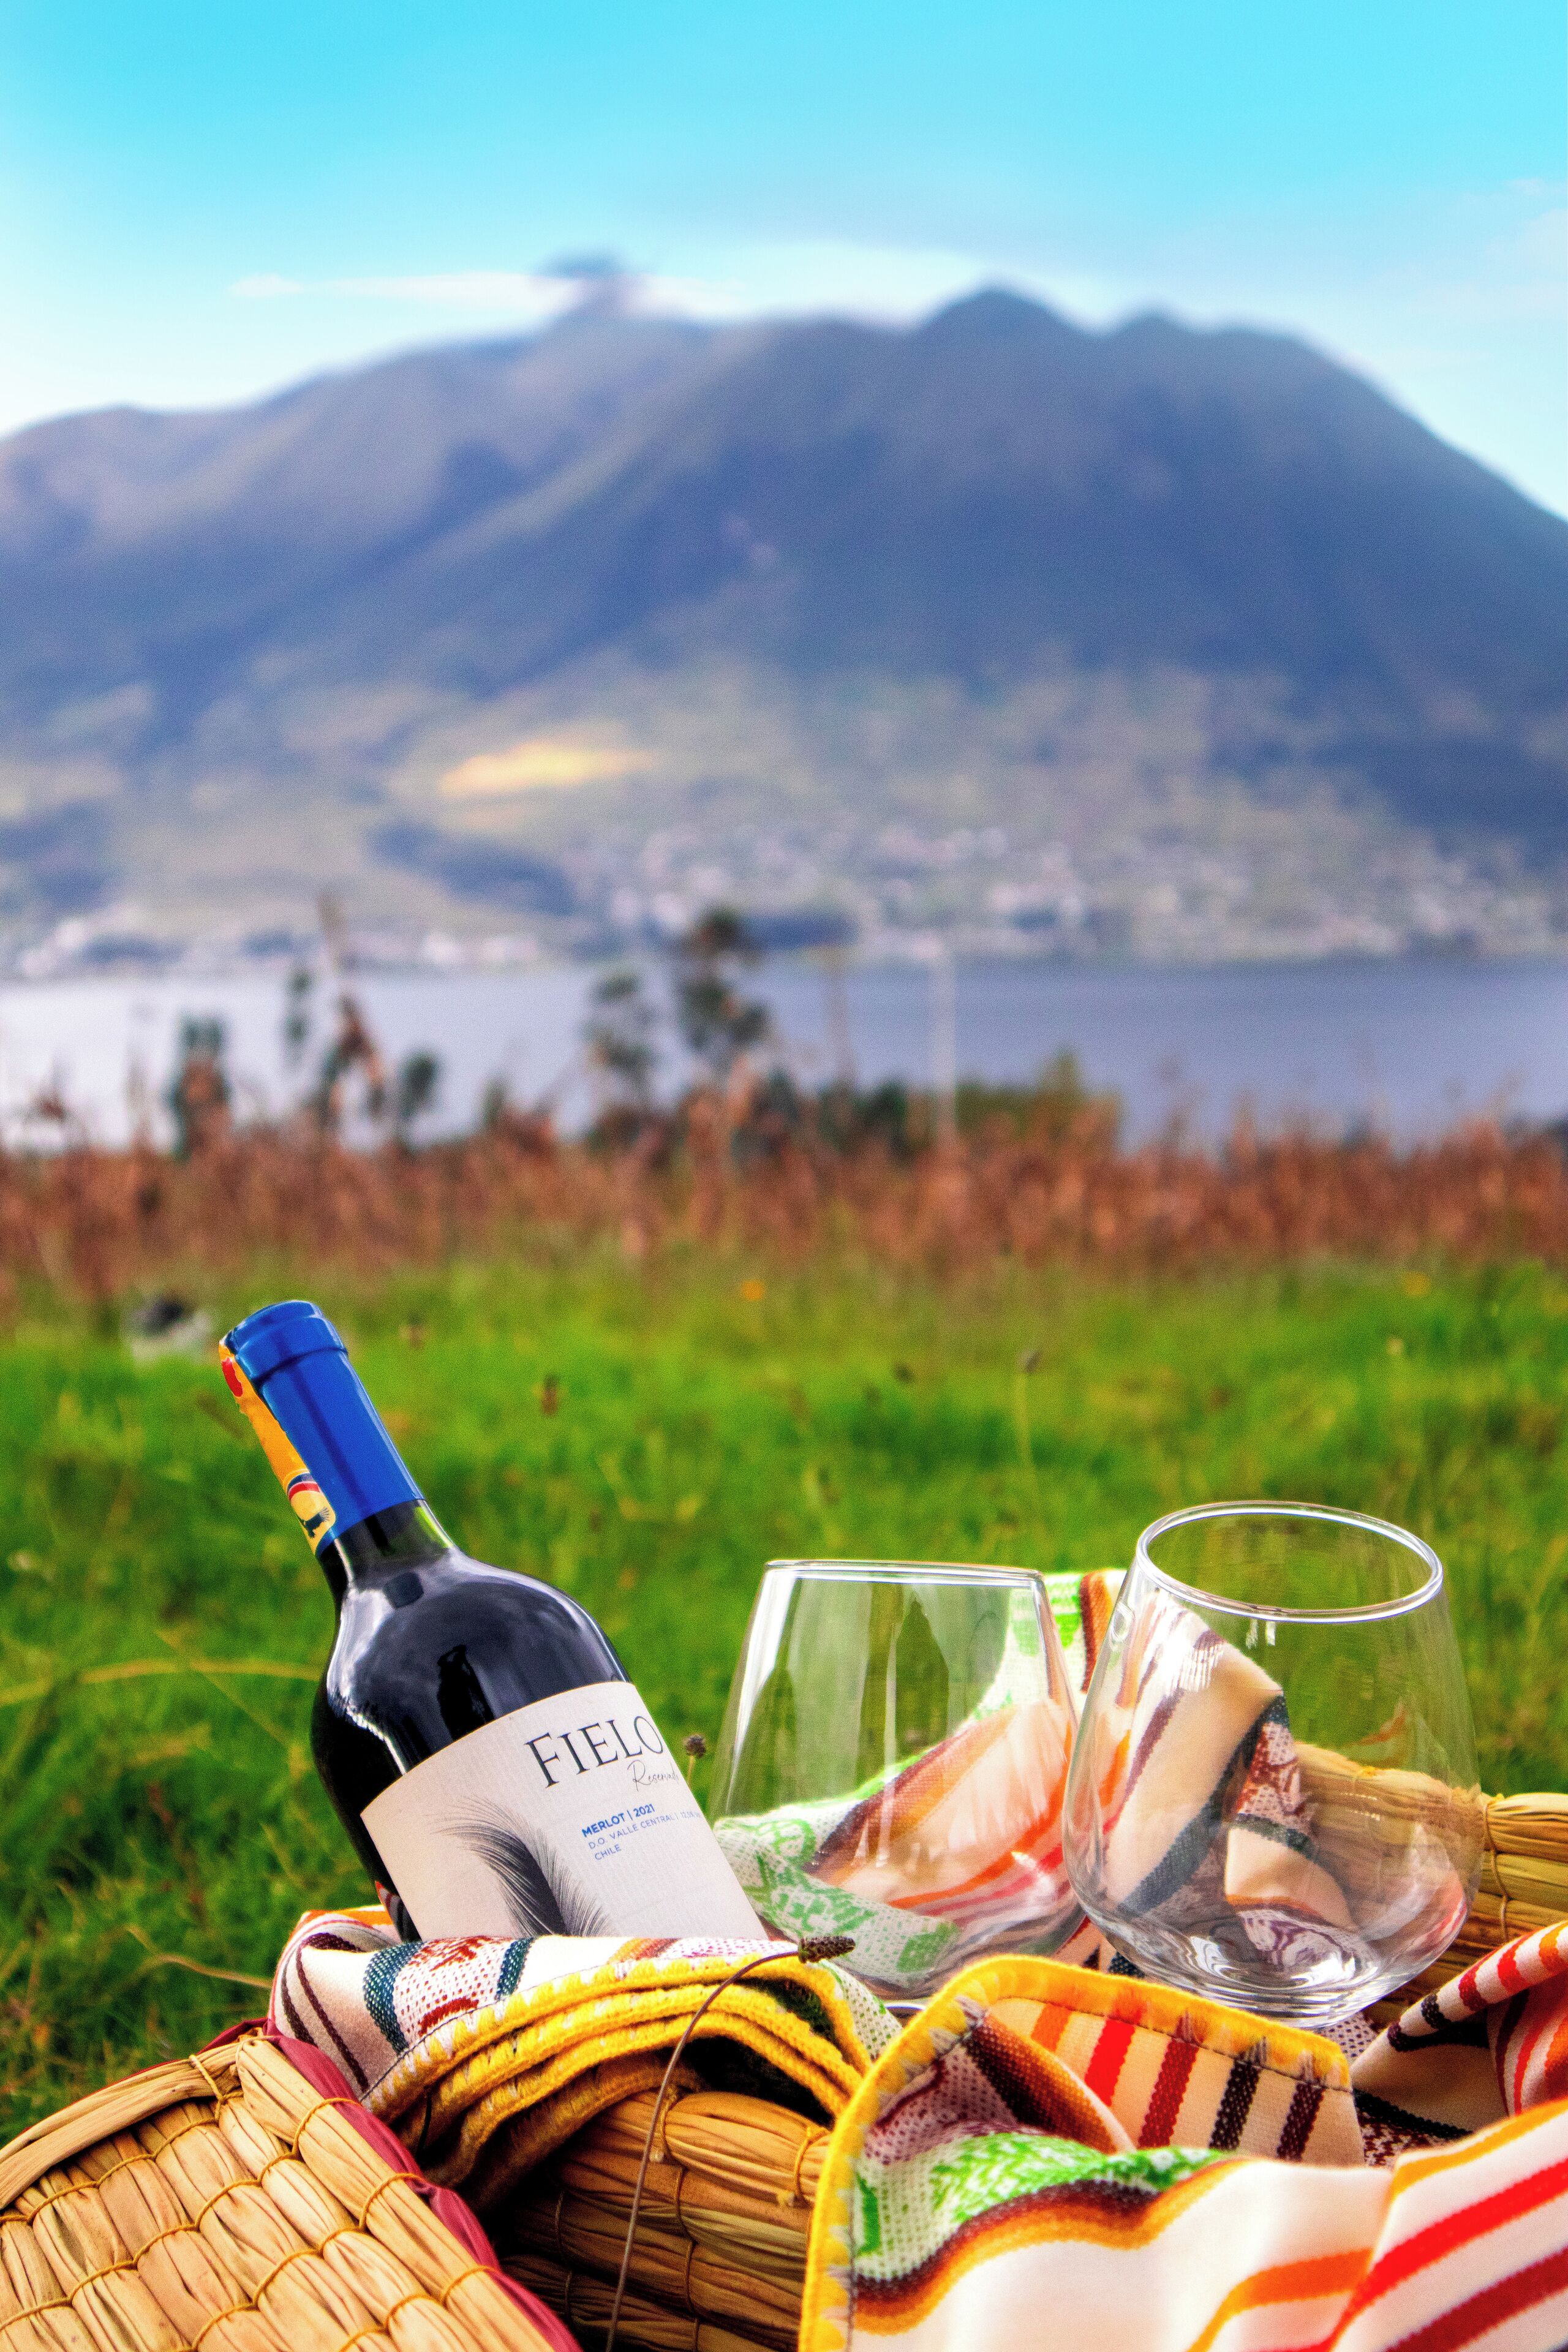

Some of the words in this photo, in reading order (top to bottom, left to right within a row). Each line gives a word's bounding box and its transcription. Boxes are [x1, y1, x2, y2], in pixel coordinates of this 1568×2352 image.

[524, 1716, 663, 1788] FIELO
[581, 1812, 625, 1838] MERLOT
[633, 1804, 655, 1817] 2021
[588, 1837, 608, 1849] D.O.
[609, 1824, 639, 1839] VALLE
[640, 1814, 675, 1829] CENTRAL
[595, 1844, 622, 1860] CHILE
